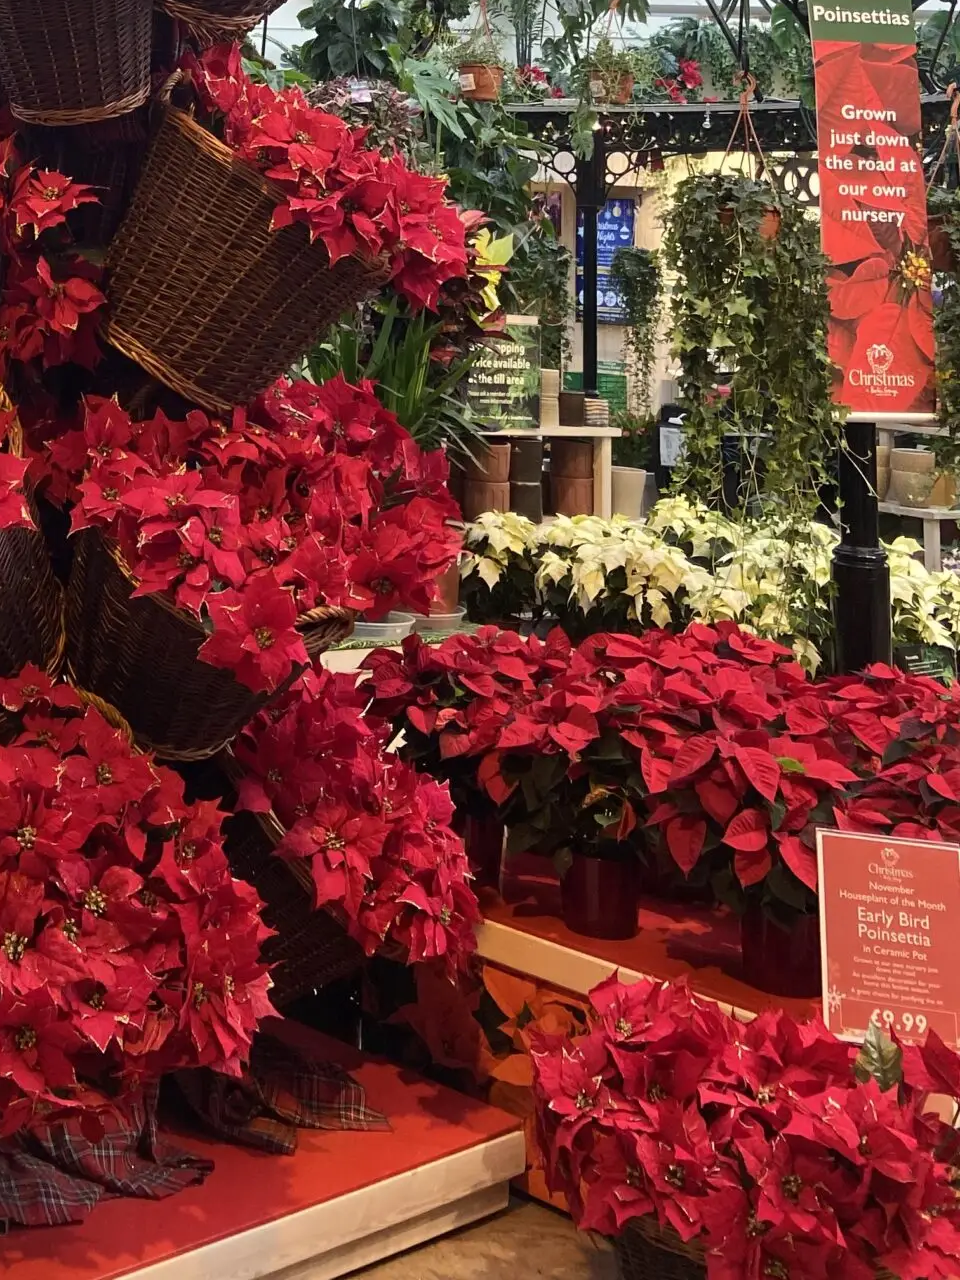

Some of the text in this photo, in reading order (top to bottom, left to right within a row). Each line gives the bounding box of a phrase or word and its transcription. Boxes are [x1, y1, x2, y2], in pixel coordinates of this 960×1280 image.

[812, 5, 910, 25] Poinsettias
[841, 104, 897, 122] Grown
[830, 129, 909, 148] just down
[825, 155, 917, 173] the road at
[838, 183, 906, 198] our own
[841, 208, 905, 227] nursery
[493, 358, 530, 369] available
[478, 373, 492, 384] the
[493, 373, 505, 384] till
[506, 376, 525, 385] area
[848, 369, 915, 387] Christmas
[868, 862, 914, 878] Christmas
[868, 881, 915, 895] November
[839, 888, 947, 911] Houseplant of the Month
[857, 906, 930, 930] Early Bird
[858, 923, 931, 947] Poinsettia
[863, 944, 928, 961] in Ceramic Pot
[870, 1008, 927, 1033] £9.99
